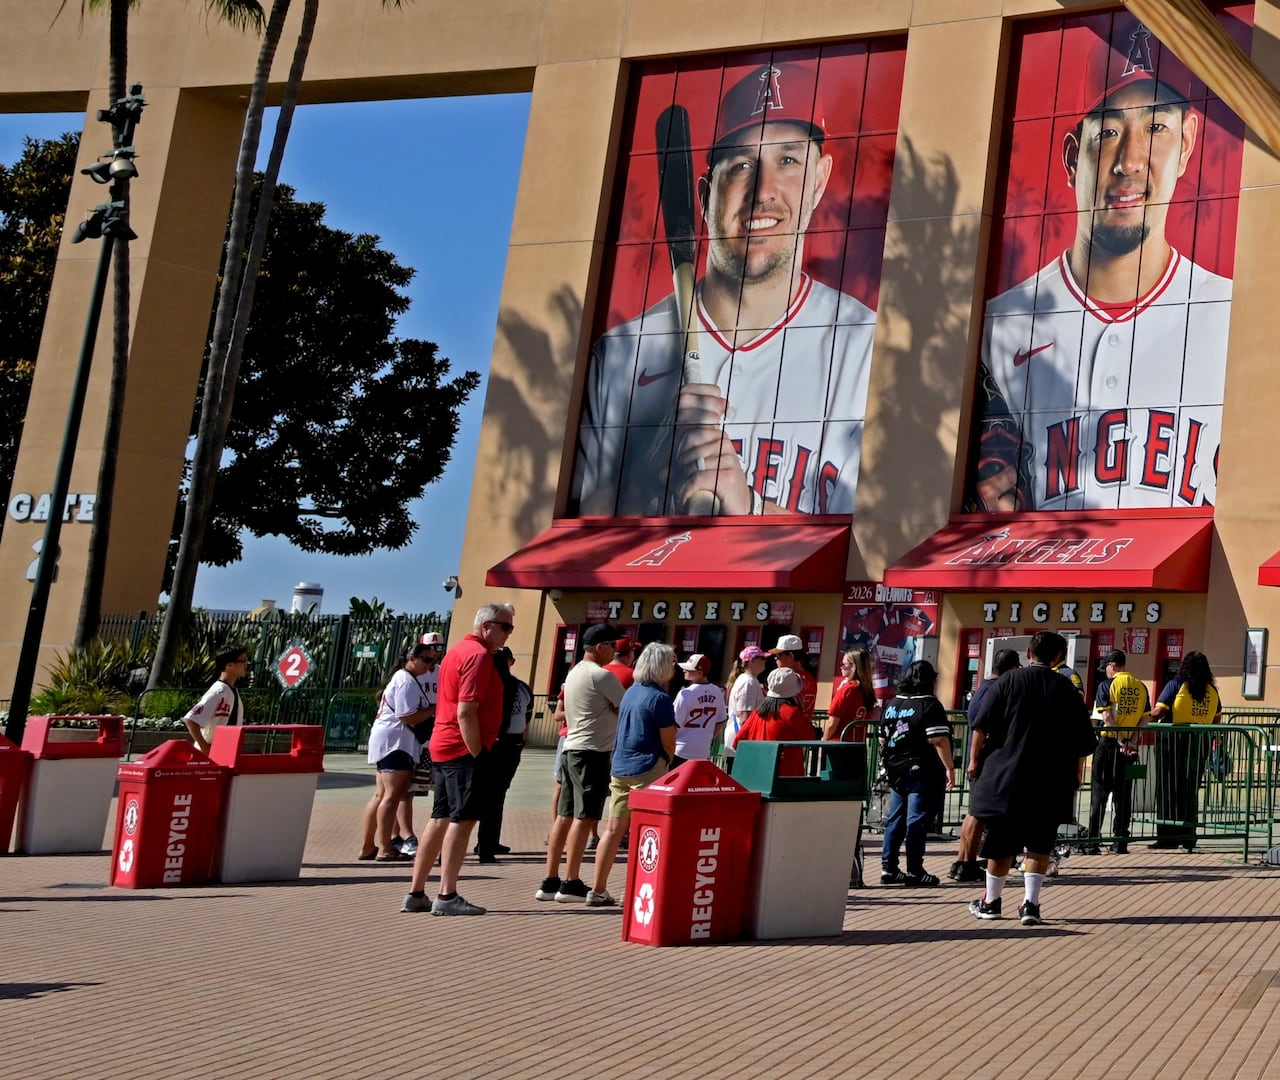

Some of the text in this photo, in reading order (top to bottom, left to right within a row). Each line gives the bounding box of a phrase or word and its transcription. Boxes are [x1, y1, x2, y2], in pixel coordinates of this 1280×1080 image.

[848, 586, 873, 600] 2026
[608, 601, 769, 620] TICKETS
[983, 602, 1161, 622] TICKETS
[286, 653, 302, 676] 2
[1119, 697, 1140, 706] EVENT
[1120, 688, 1140, 697] CSC
[684, 707, 717, 728] 27
[1119, 707, 1138, 715] STAFF
[1191, 708, 1209, 717] STAFF
[163, 793, 193, 883] RECYCLE
[690, 827, 721, 939] RECYCLE
